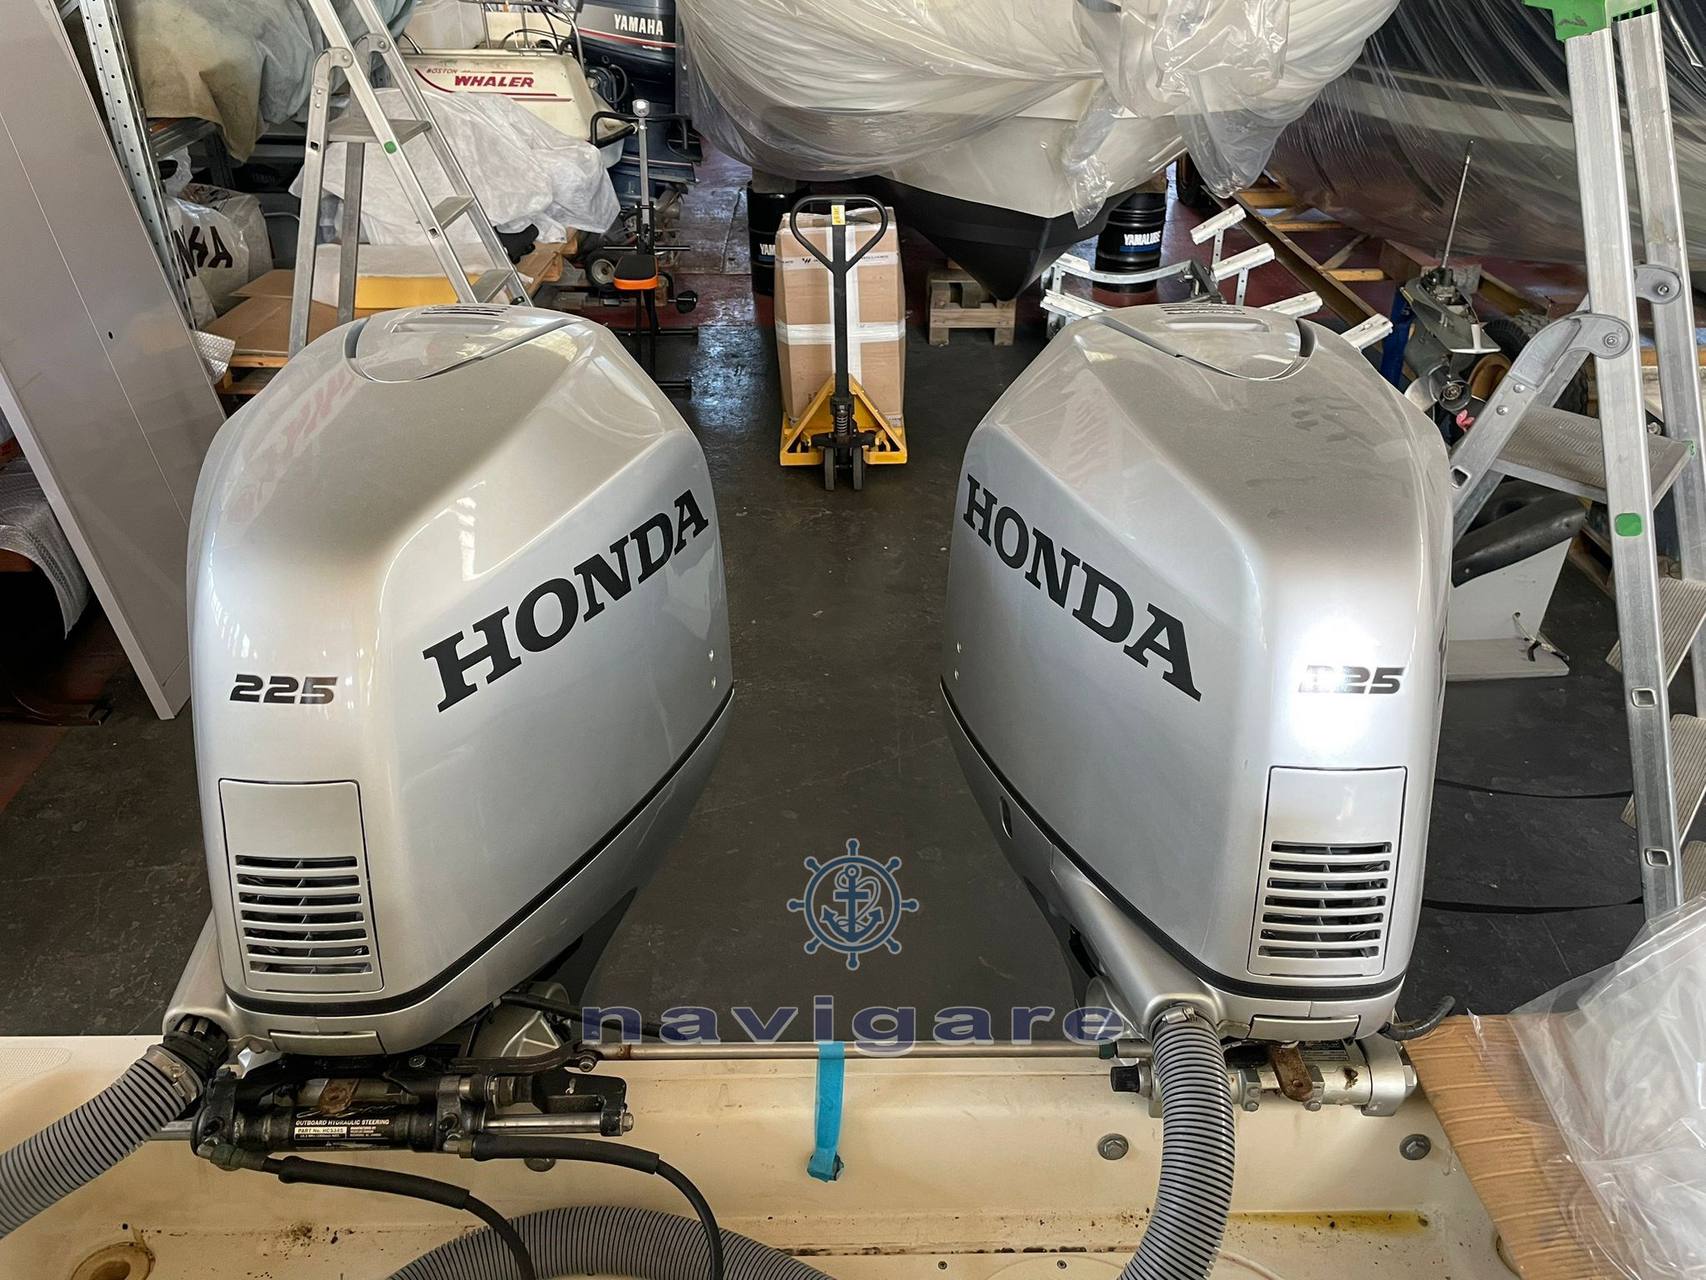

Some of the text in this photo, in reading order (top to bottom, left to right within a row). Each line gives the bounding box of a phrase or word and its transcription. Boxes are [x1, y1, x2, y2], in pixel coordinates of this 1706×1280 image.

[614, 13, 664, 36] YAMAHA
[455, 75, 535, 88] WHALER
[422, 489, 709, 713] HONDA
[963, 473, 1202, 702] HONDA
[229, 673, 338, 705] 225
